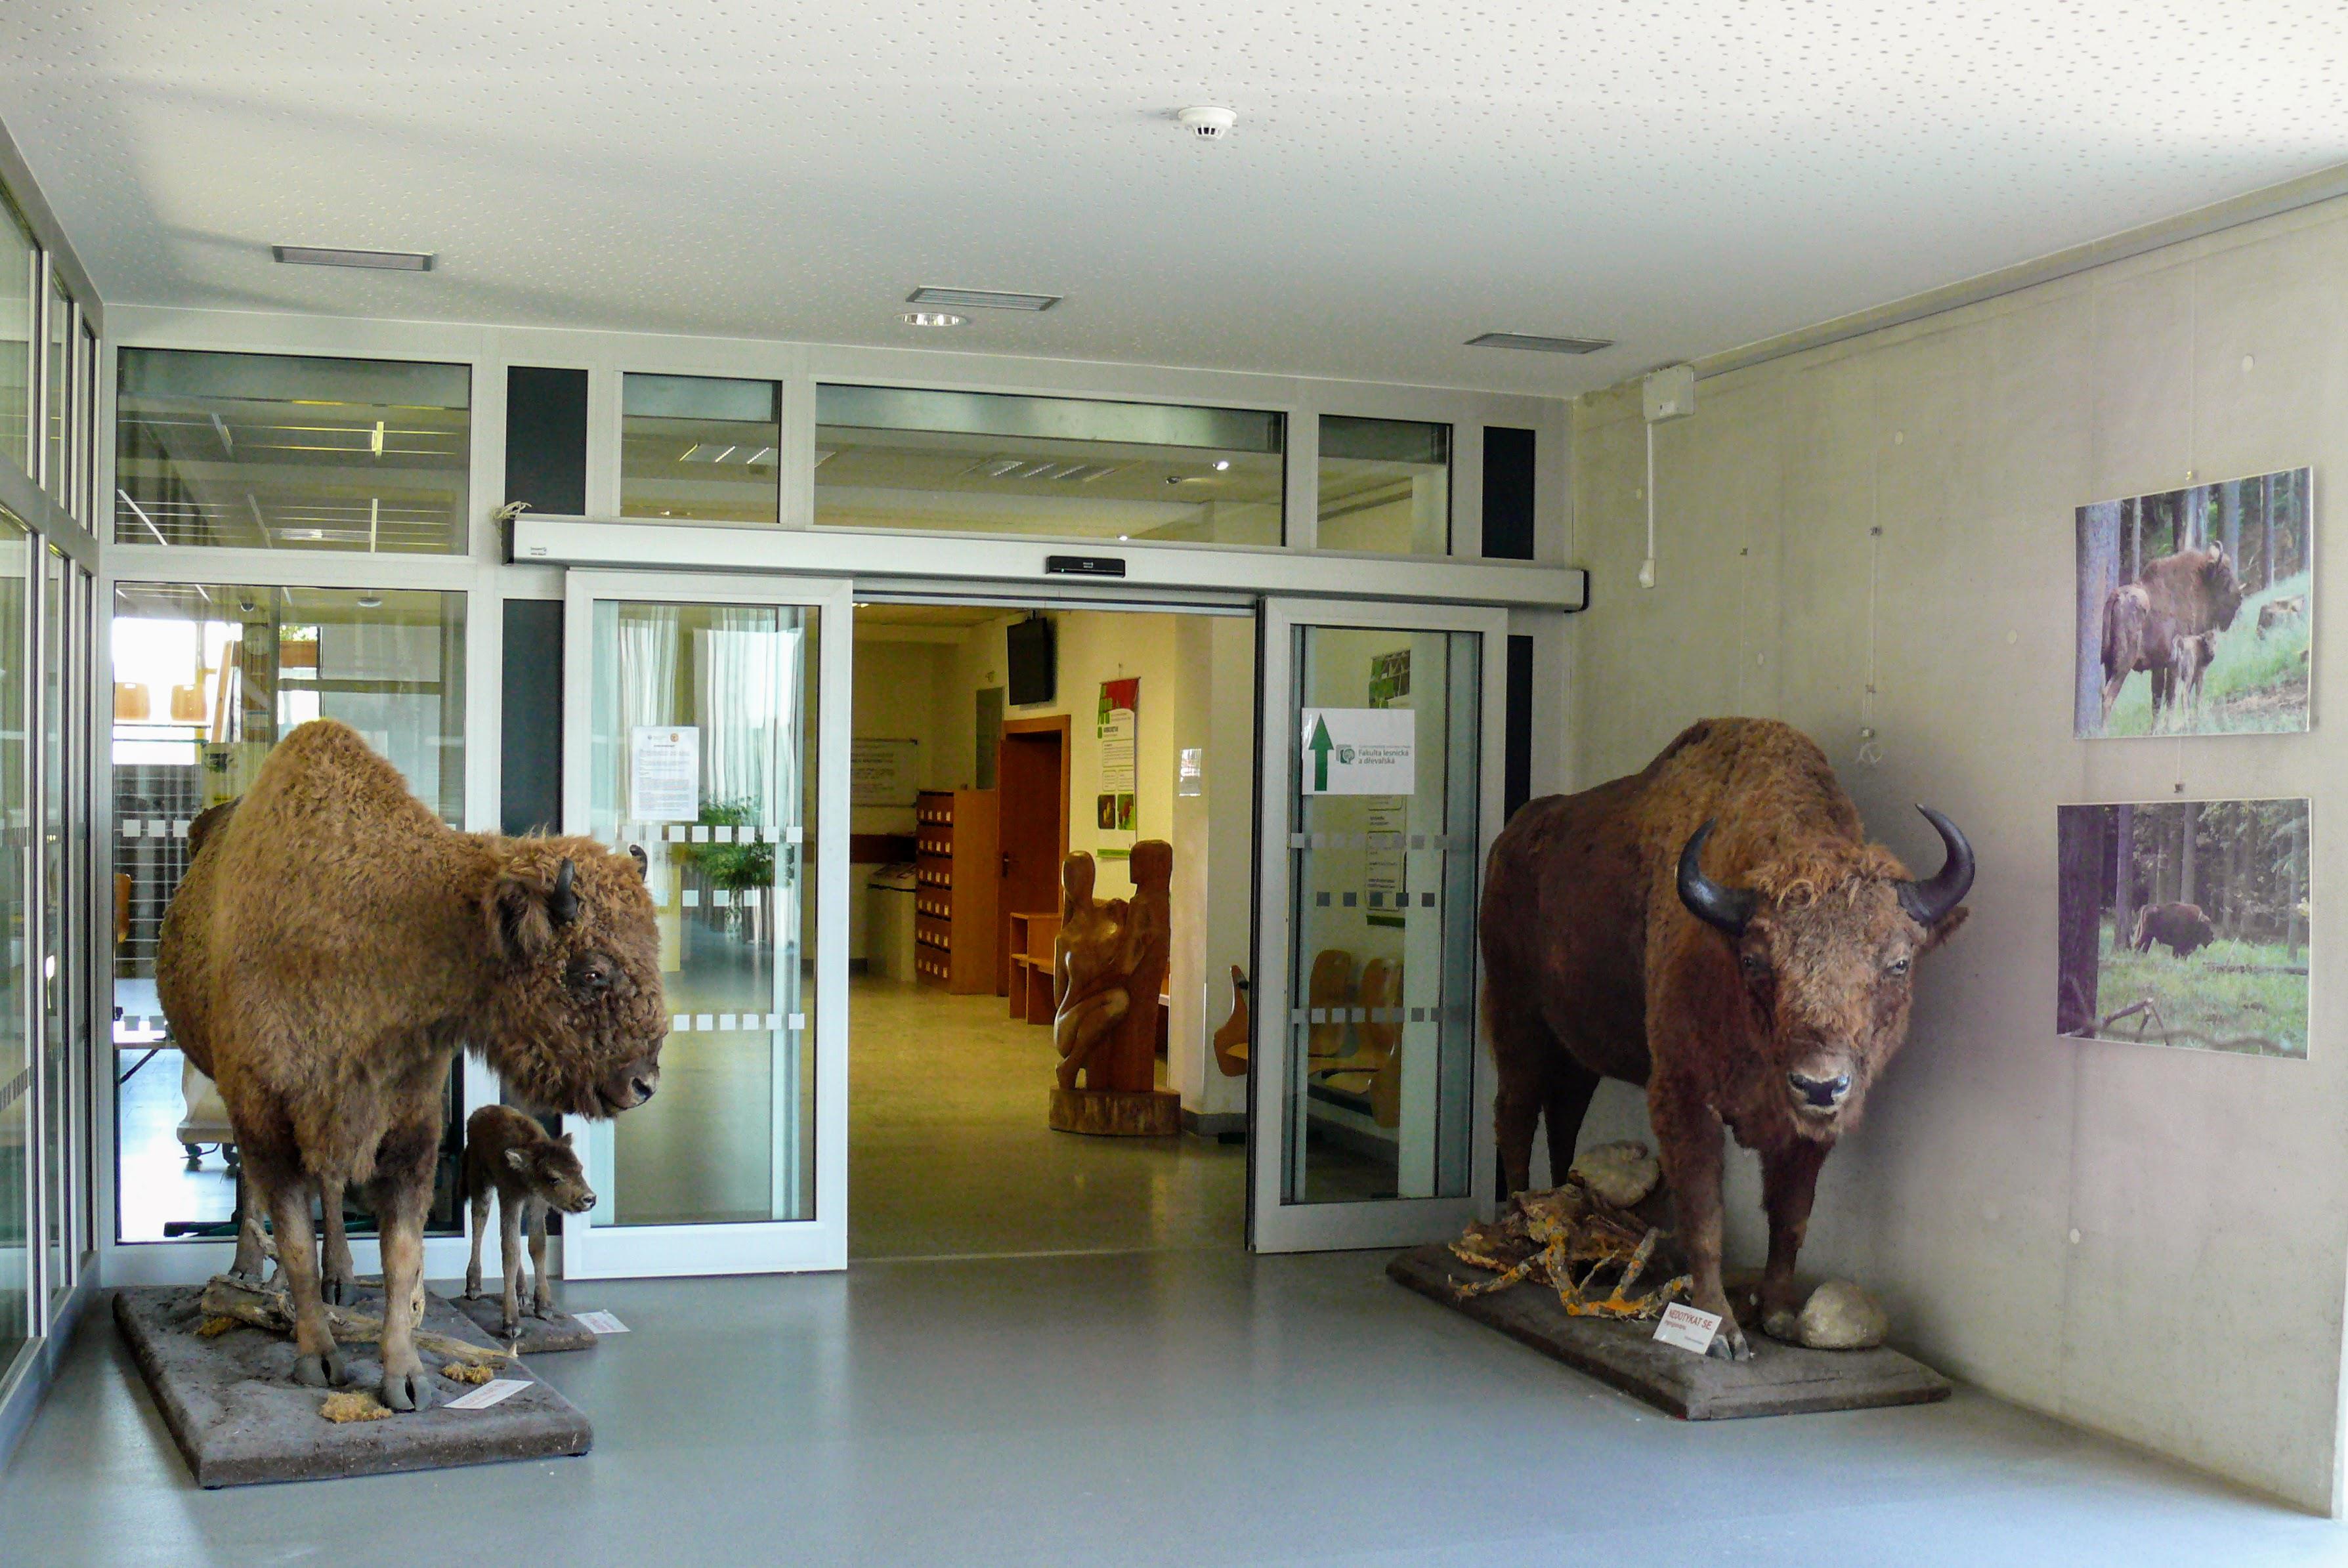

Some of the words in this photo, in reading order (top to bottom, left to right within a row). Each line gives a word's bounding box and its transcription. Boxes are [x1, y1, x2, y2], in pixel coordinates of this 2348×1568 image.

[1383, 748, 1409, 757] lesnická
[1669, 1309, 1703, 1326] NEDOTYKAT
[1701, 1319, 1713, 1330] SE
